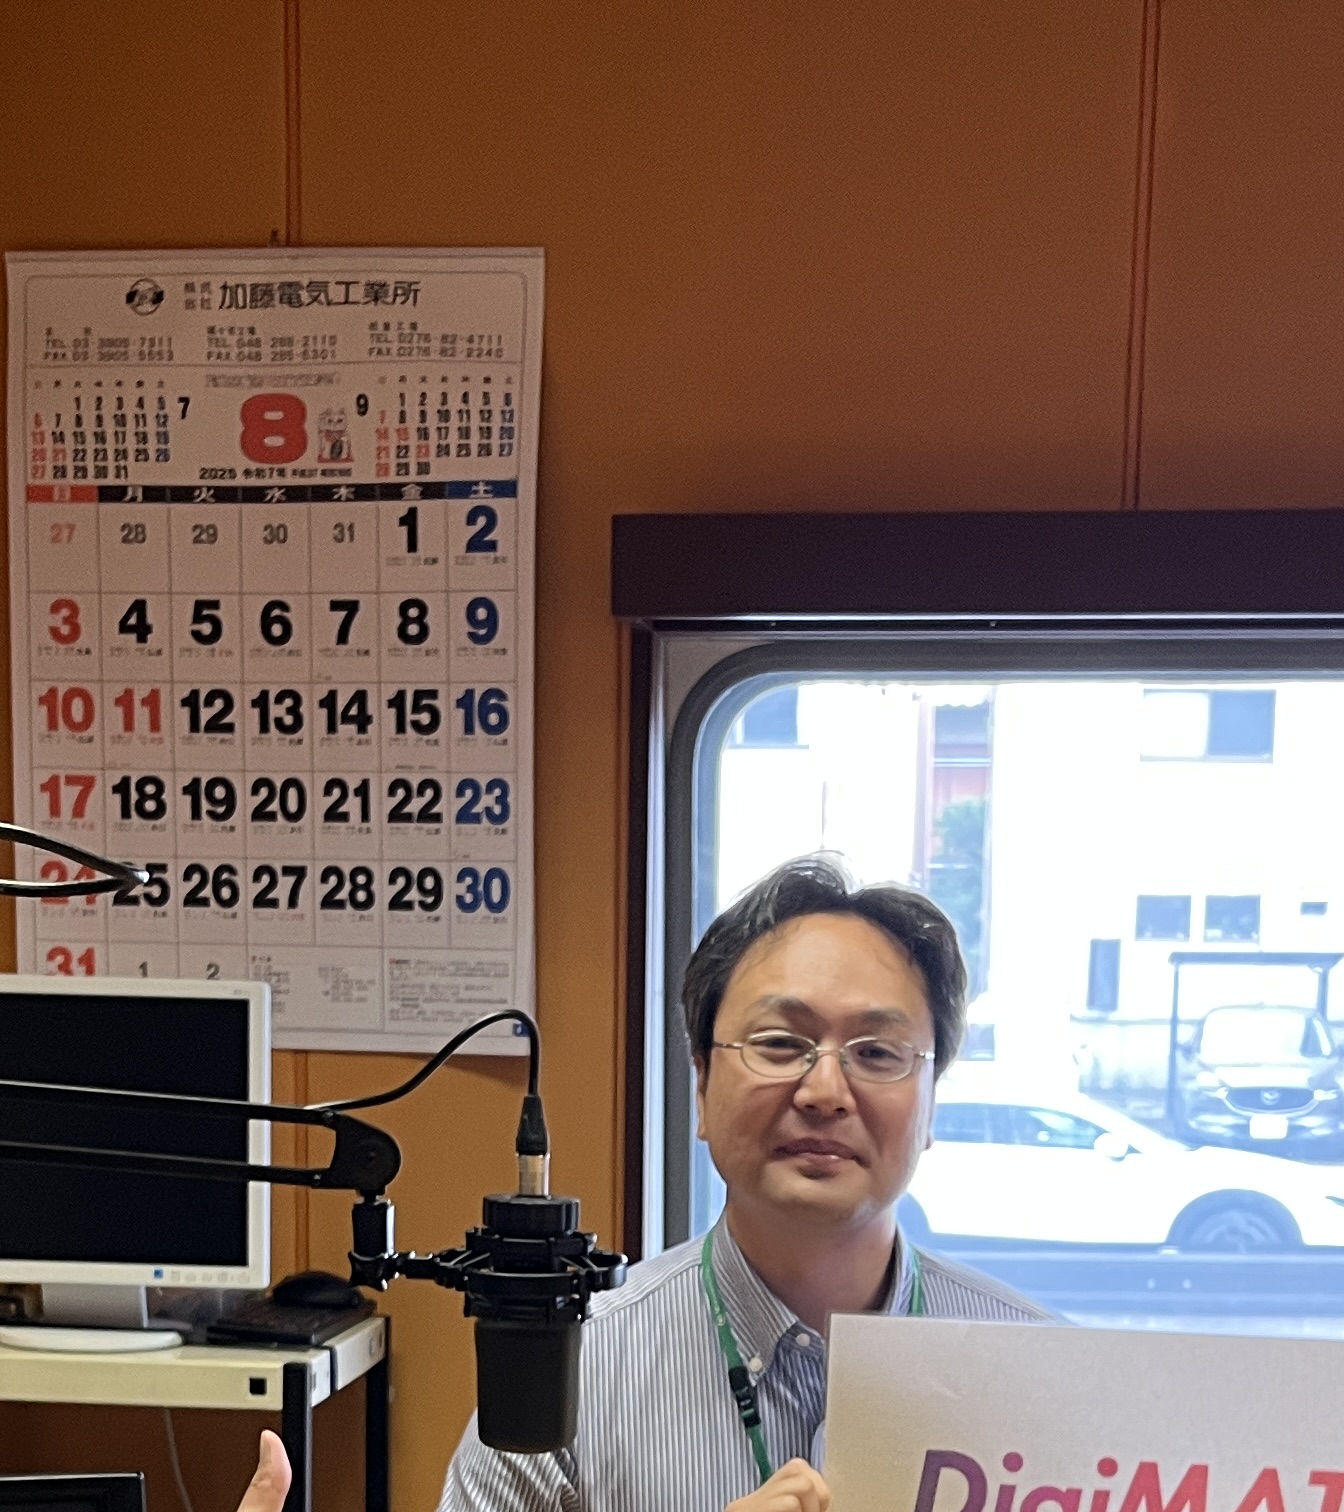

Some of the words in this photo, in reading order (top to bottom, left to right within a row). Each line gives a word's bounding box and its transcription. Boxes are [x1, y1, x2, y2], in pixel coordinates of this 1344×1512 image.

[178, 397, 190, 419] 7
[240, 393, 308, 464] 8
[356, 394, 368, 416] 9
[122, 485, 146, 502] 月
[192, 486, 217, 502] 火
[262, 486, 288, 502] 水
[331, 486, 357, 502] 木
[468, 481, 494, 498] 土
[50, 523, 76, 544] 27
[120, 523, 146, 544] 28
[192, 524, 218, 545] 29
[263, 524, 288, 545] 30
[333, 522, 354, 543] 31
[399, 507, 418, 553] 1
[465, 505, 497, 553] 2
[49, 599, 81, 645] 3
[119, 599, 152, 644] 4
[191, 600, 222, 645] 5
[260, 600, 292, 647] 6
[330, 600, 359, 645] 7
[397, 598, 429, 645] 8
[466, 597, 498, 645] 9
[38, 687, 95, 733] 10
[114, 688, 161, 733] 11
[181, 689, 235, 734] 12
[251, 689, 303, 735] 13
[319, 689, 373, 734] 14
[387, 689, 441, 735] 15
[456, 688, 509, 735] 16
[40, 774, 96, 819] 17
[112, 776, 166, 820] 18
[182, 777, 236, 822] 19
[251, 777, 306, 823] 20
[323, 778, 370, 823] 21
[388, 778, 442, 823] 22
[455, 778, 510, 825] 23
[183, 863, 239, 908] 26
[253, 865, 307, 909] 27
[320, 866, 375, 911] 28
[388, 867, 443, 912] 29
[456, 867, 510, 913] 30
[45, 945, 96, 977] 31
[138, 961, 149, 978] 1
[206, 962, 221, 980] 2
